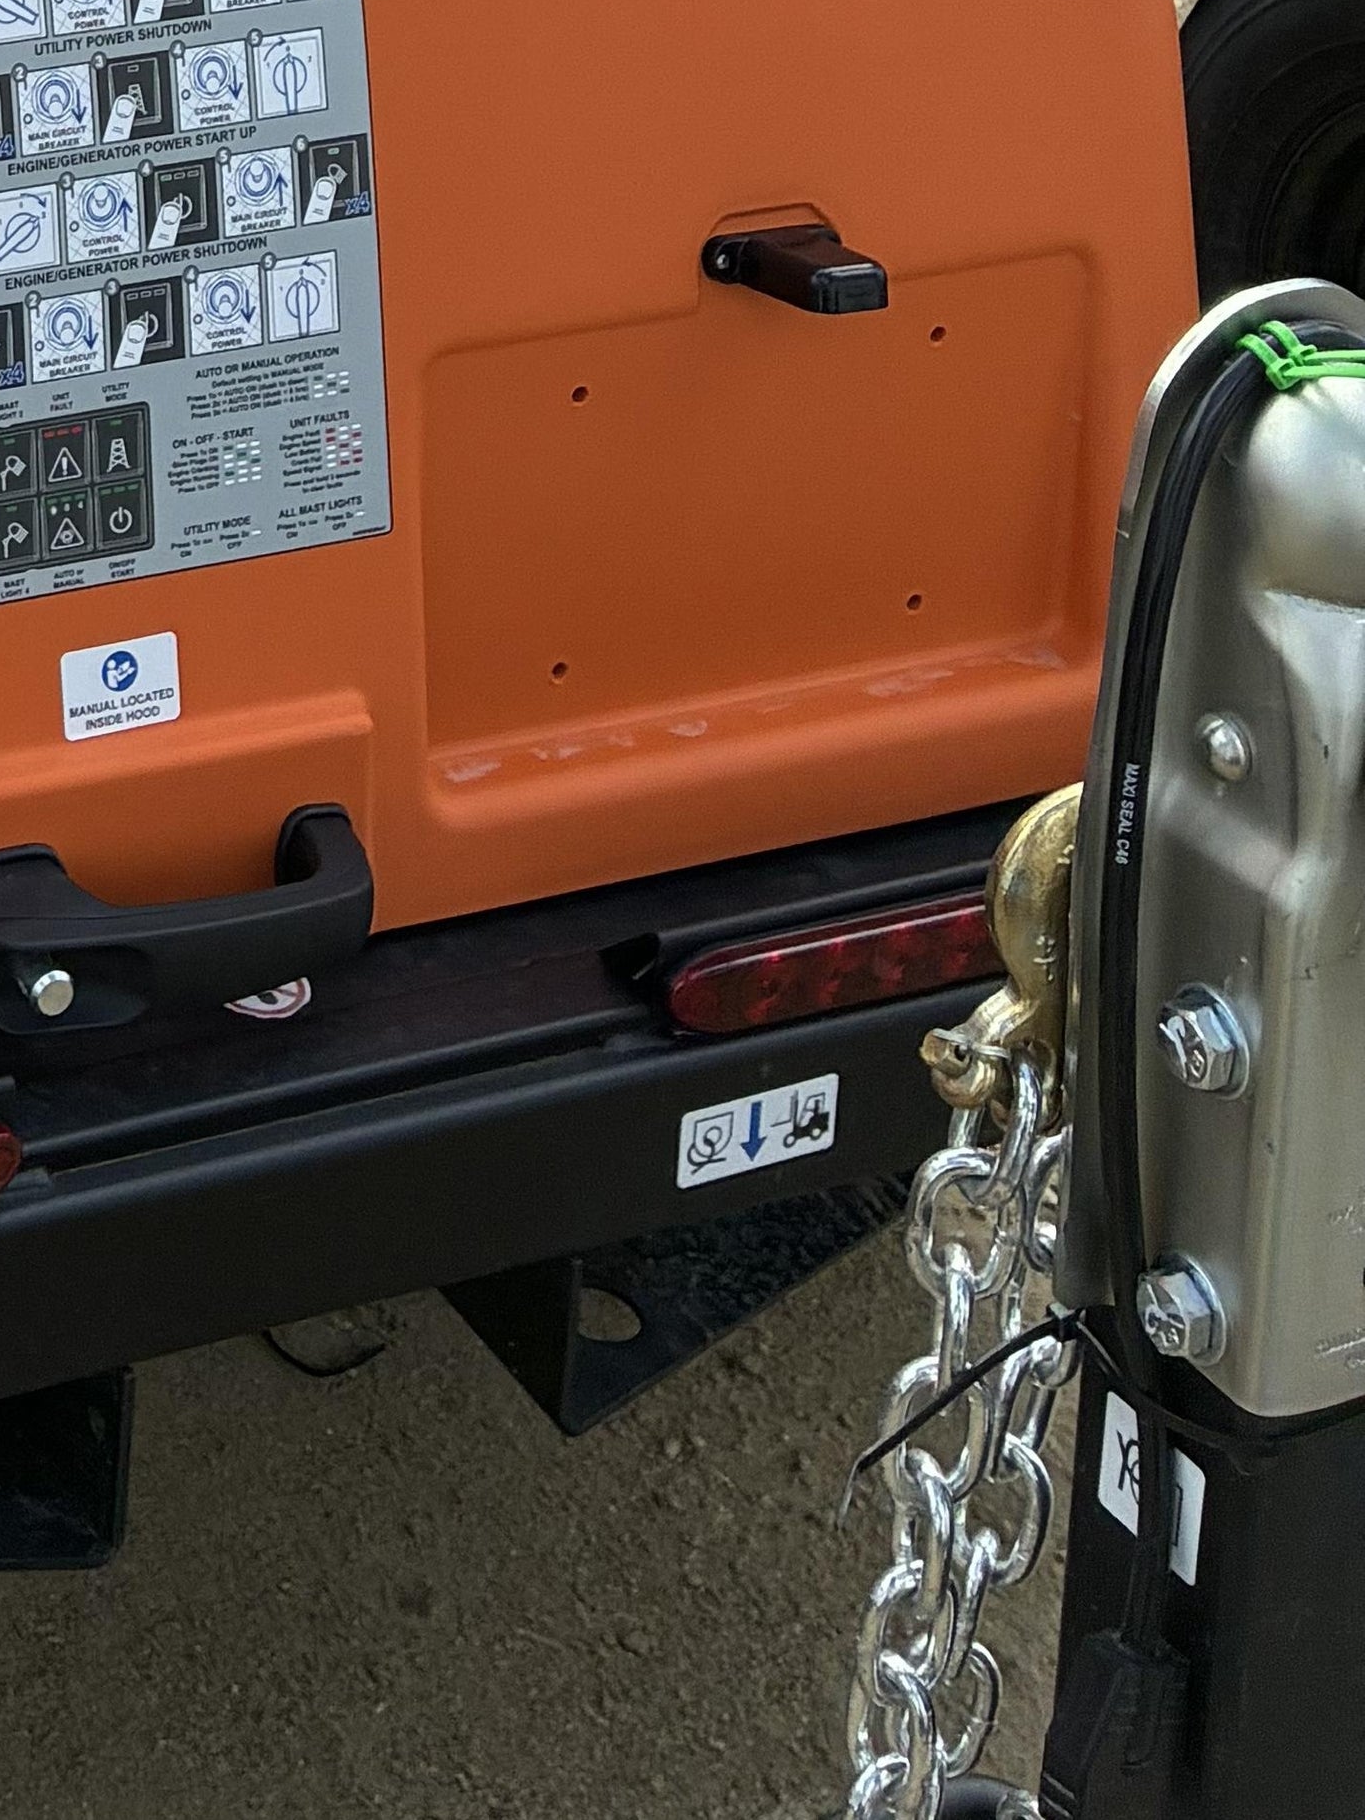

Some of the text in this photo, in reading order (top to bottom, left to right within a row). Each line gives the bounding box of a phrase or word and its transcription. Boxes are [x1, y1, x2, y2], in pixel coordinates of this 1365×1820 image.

[34, 18, 211, 55] UTILITY POWER SHUTDOWN
[7, 125, 256, 175] ENGINE/GENERATOR POWER START UP
[5, 235, 267, 289] ENGINE/GENERATOR POWER SHUTDOWN
[195, 346, 339, 379] AUTO OR MANUAL OPERATION
[289, 409, 349, 428] UNIT FAULTS
[172, 426, 254, 449] ON OFF START
[183, 515, 250, 536] UTILITY MODE
[69, 687, 175, 718] MANUAL LOCATED
[85, 705, 160, 730] INSIDE HOOD
[1122, 762, 1141, 797] MAXI
[1117, 799, 1135, 835] SEAL
